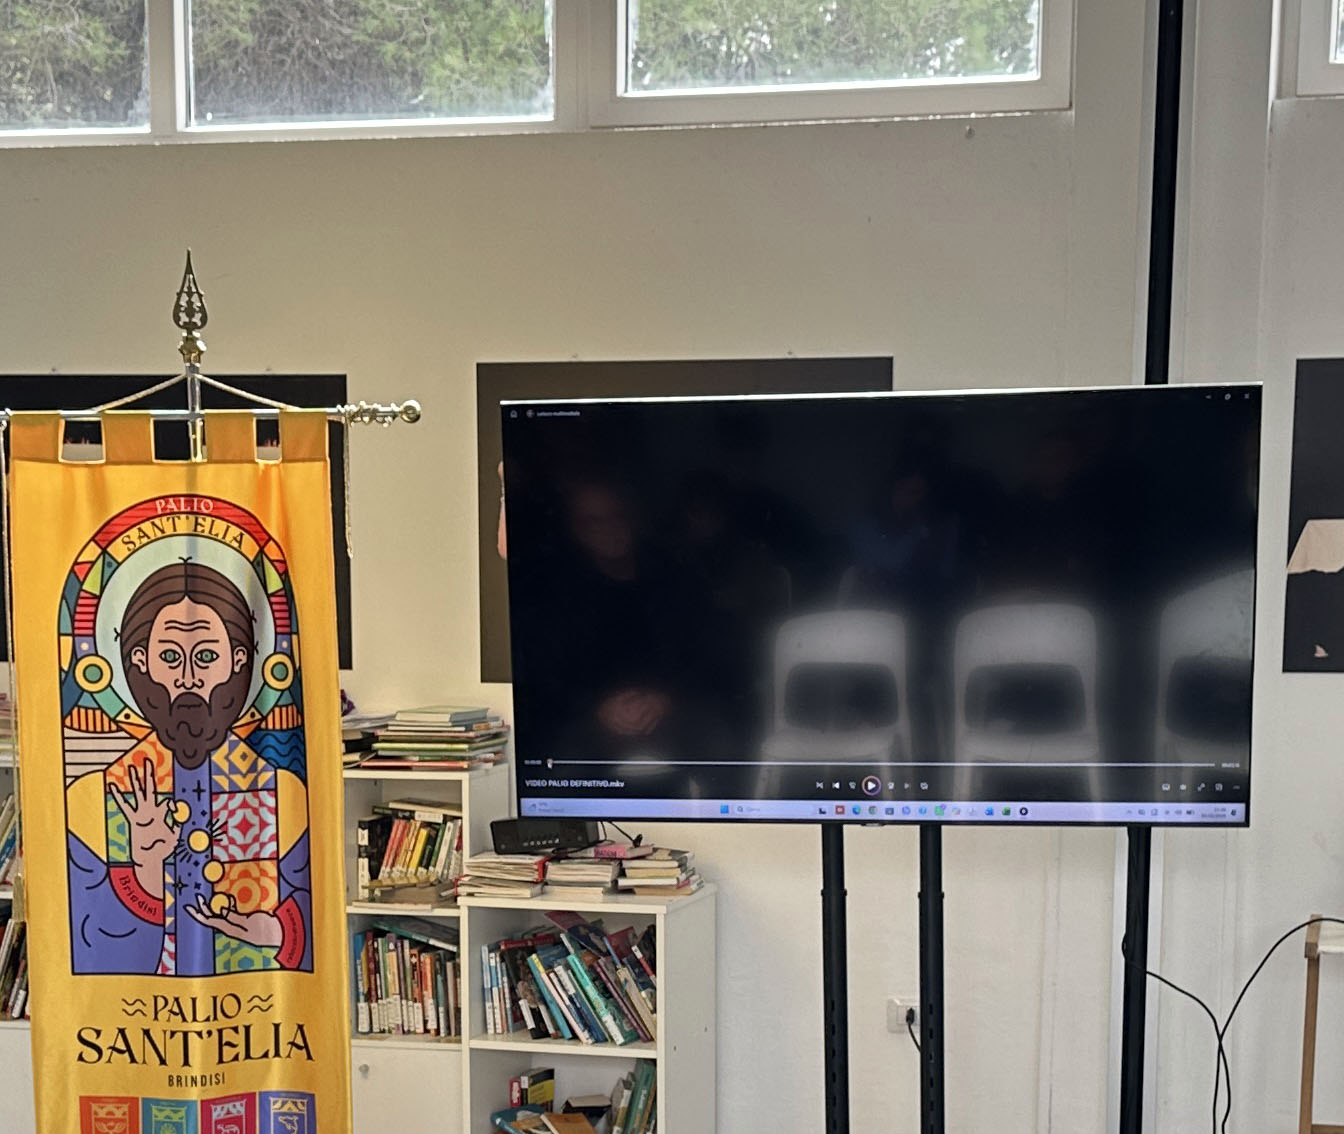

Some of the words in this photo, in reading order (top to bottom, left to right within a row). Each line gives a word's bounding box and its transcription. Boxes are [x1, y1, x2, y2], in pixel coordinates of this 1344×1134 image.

[155, 497, 214, 514] PALIO
[121, 516, 246, 552] SANT'ELIA
[152, 992, 242, 1024] PALIO
[76, 1022, 315, 1068] SANT'ELIA
[167, 1072, 226, 1088] BRINDISI
